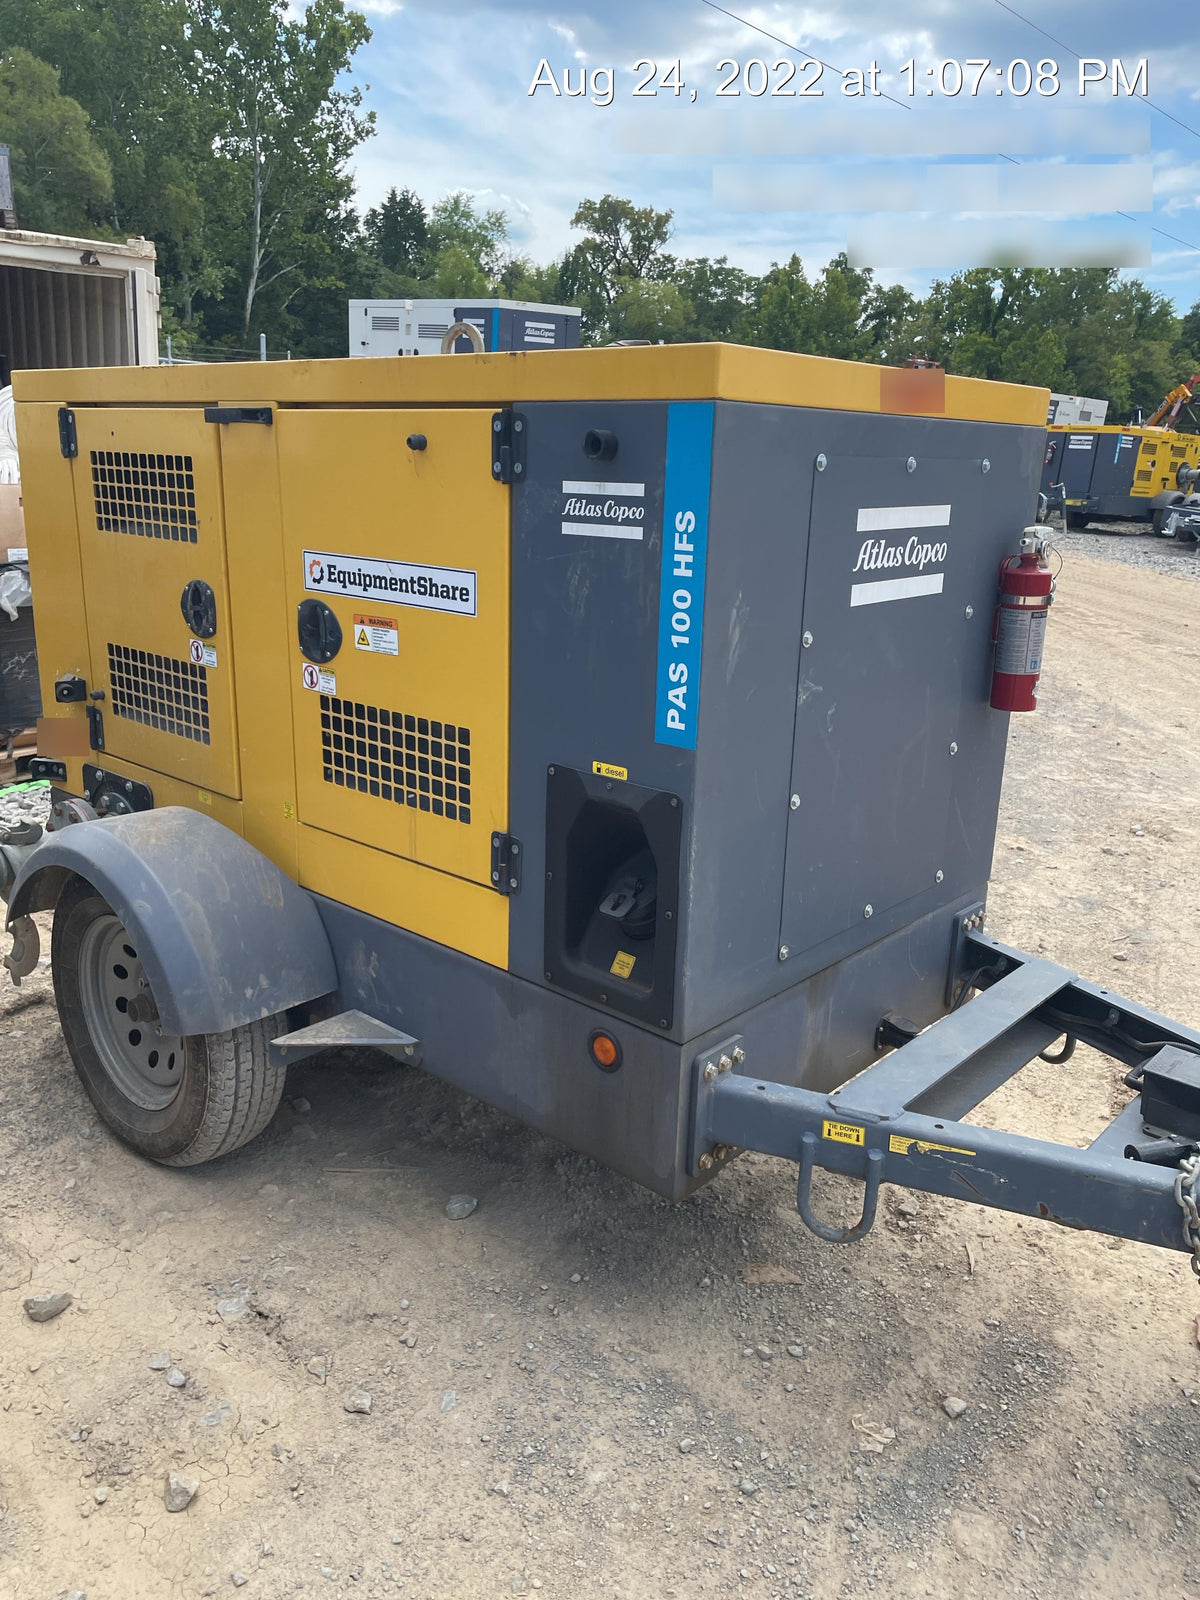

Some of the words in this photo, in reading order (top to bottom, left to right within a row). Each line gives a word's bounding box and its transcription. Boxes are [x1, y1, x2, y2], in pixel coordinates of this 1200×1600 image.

[561, 498, 602, 519] Atlas
[603, 500, 644, 522] Copco
[673, 510, 696, 577] HFS
[852, 539, 904, 572] Atlas
[904, 536, 948, 571] Copco
[326, 564, 470, 603] EquipmentShare
[368, 618, 393, 628] WARNING
[671, 588, 692, 648] 100
[666, 662, 689, 731] PAS
[604, 767, 625, 778] diesel
[828, 1122, 838, 1130] TIE
[839, 1125, 860, 1134] DOWN
[834, 1130, 853, 1140] HERE
